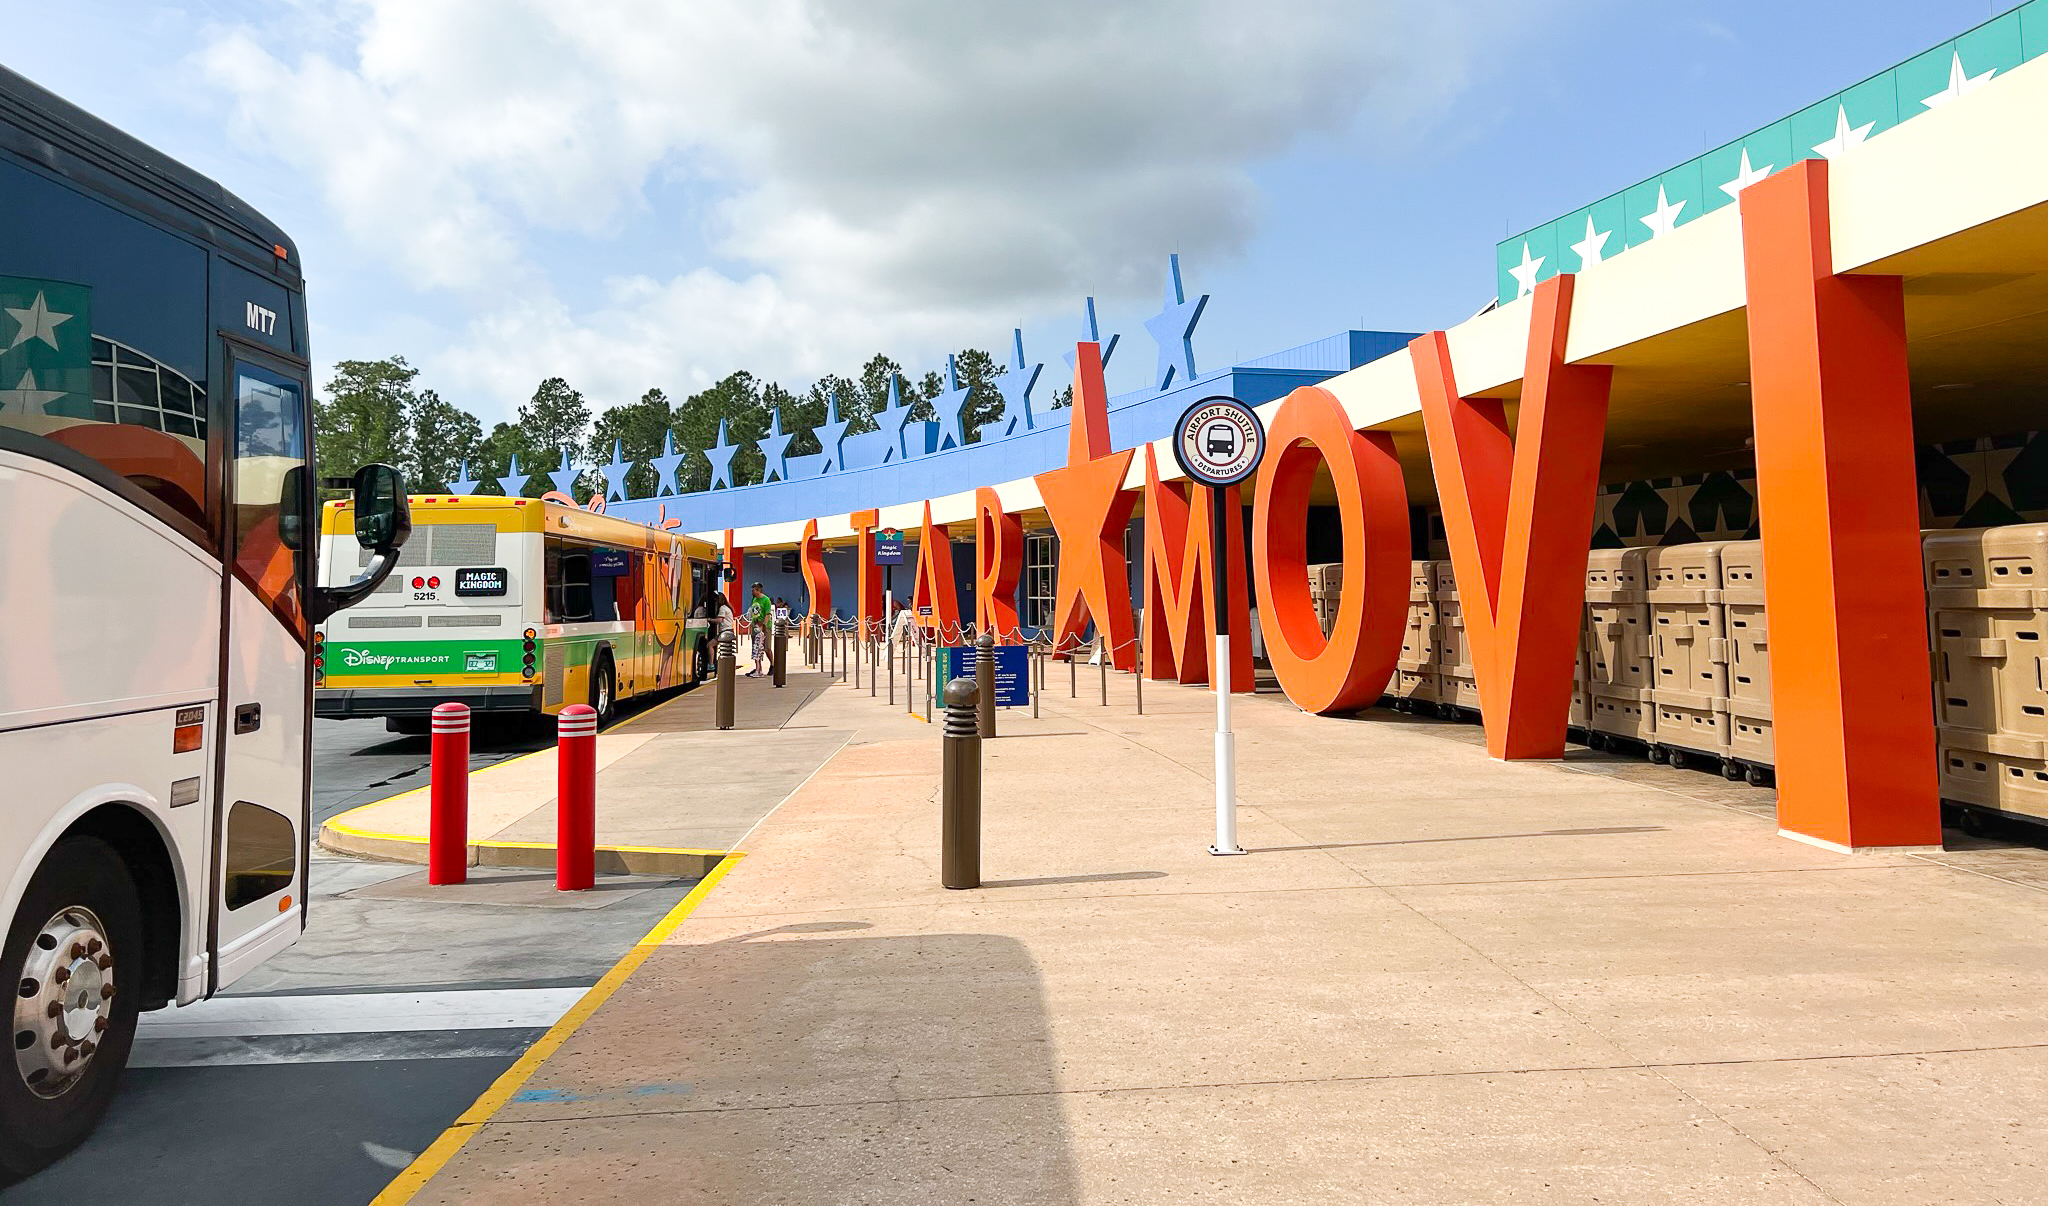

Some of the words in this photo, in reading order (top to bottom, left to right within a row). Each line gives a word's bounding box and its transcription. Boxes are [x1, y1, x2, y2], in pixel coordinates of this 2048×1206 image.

[246, 301, 277, 336] MT7
[1186, 407, 1221, 441] AIRPORT
[1224, 408, 1255, 443] SHUTTLE
[1197, 461, 1243, 476] DEPARTURES
[465, 572, 497, 581] MAGIC
[459, 580, 502, 589] KINGDOM
[413, 592, 436, 601] 5215
[340, 648, 395, 671] Disney
[395, 655, 450, 663] TRANSPORT
